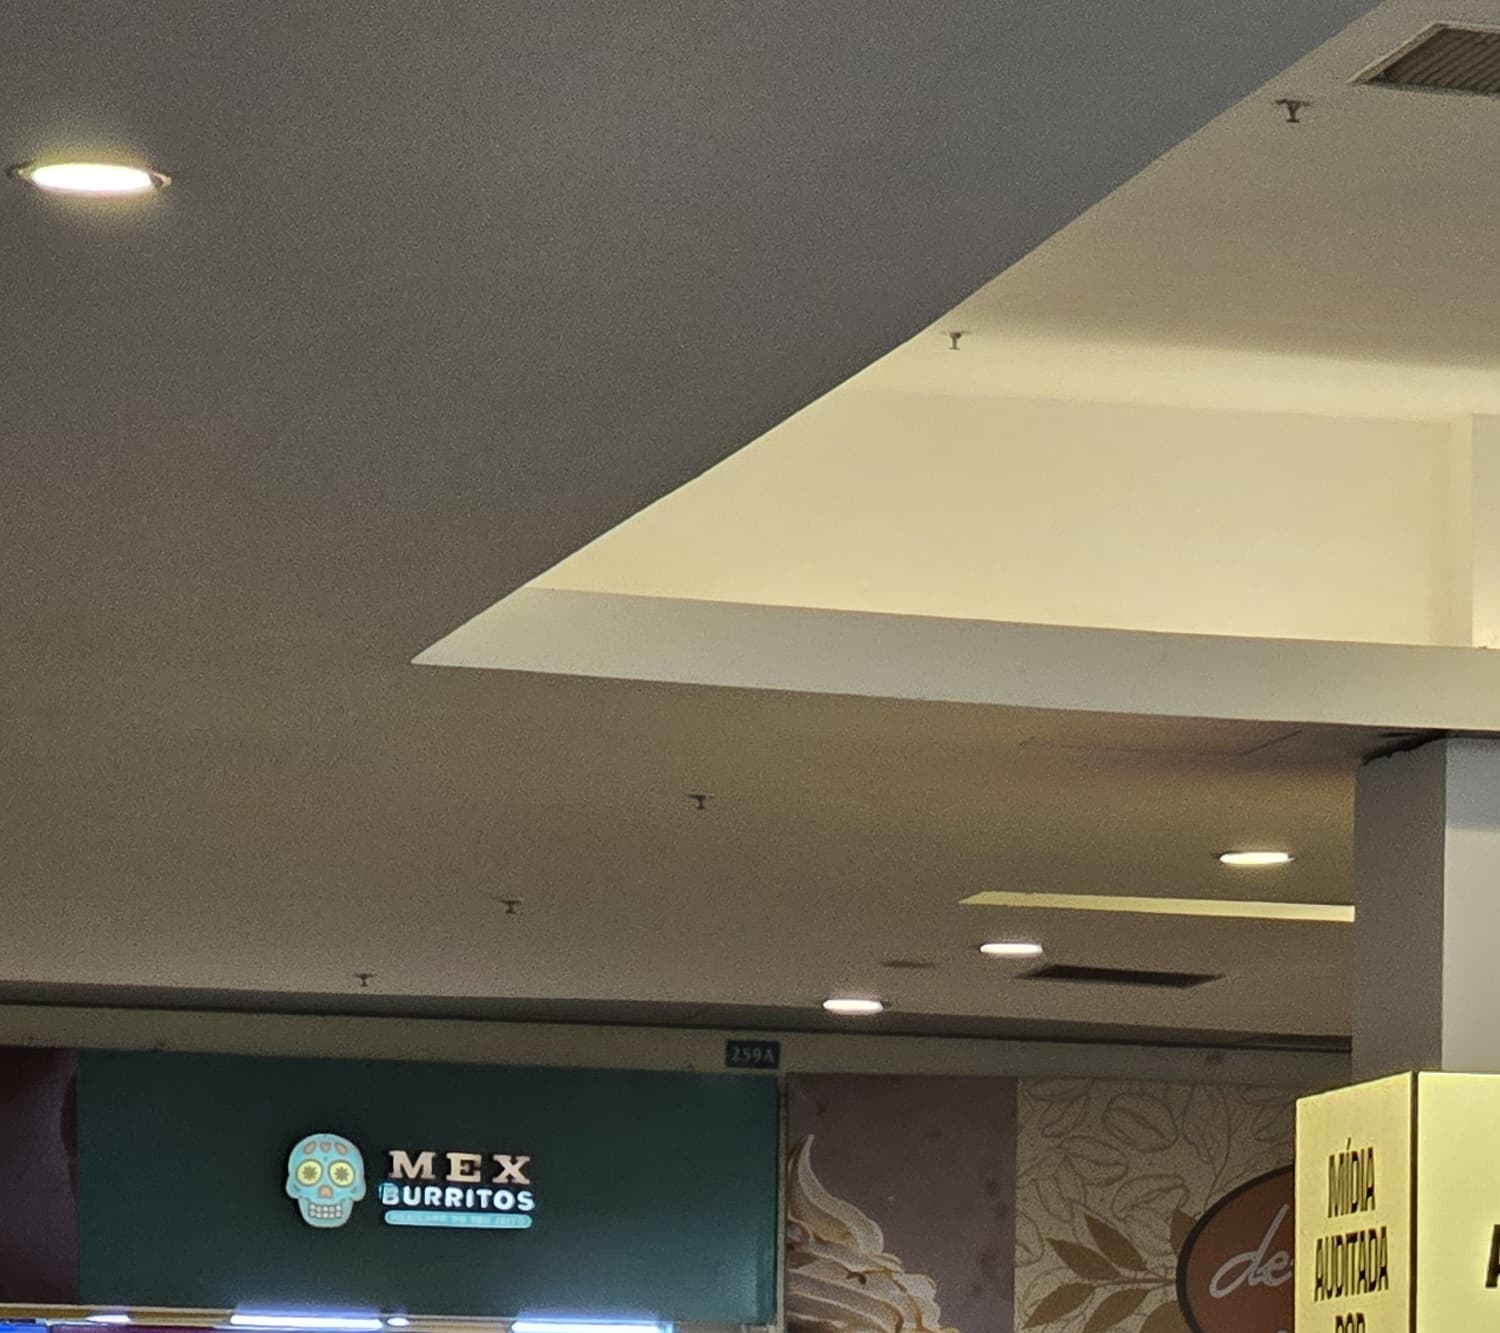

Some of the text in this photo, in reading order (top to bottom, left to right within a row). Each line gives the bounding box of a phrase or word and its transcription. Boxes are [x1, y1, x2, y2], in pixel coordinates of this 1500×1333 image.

[731, 1046, 775, 1064] 259A
[388, 1150, 531, 1185] MEX
[1327, 1138, 1376, 1218] MÍDIA
[379, 1182, 536, 1212] BURRITOS
[1314, 1227, 1389, 1302] AUDITADA
